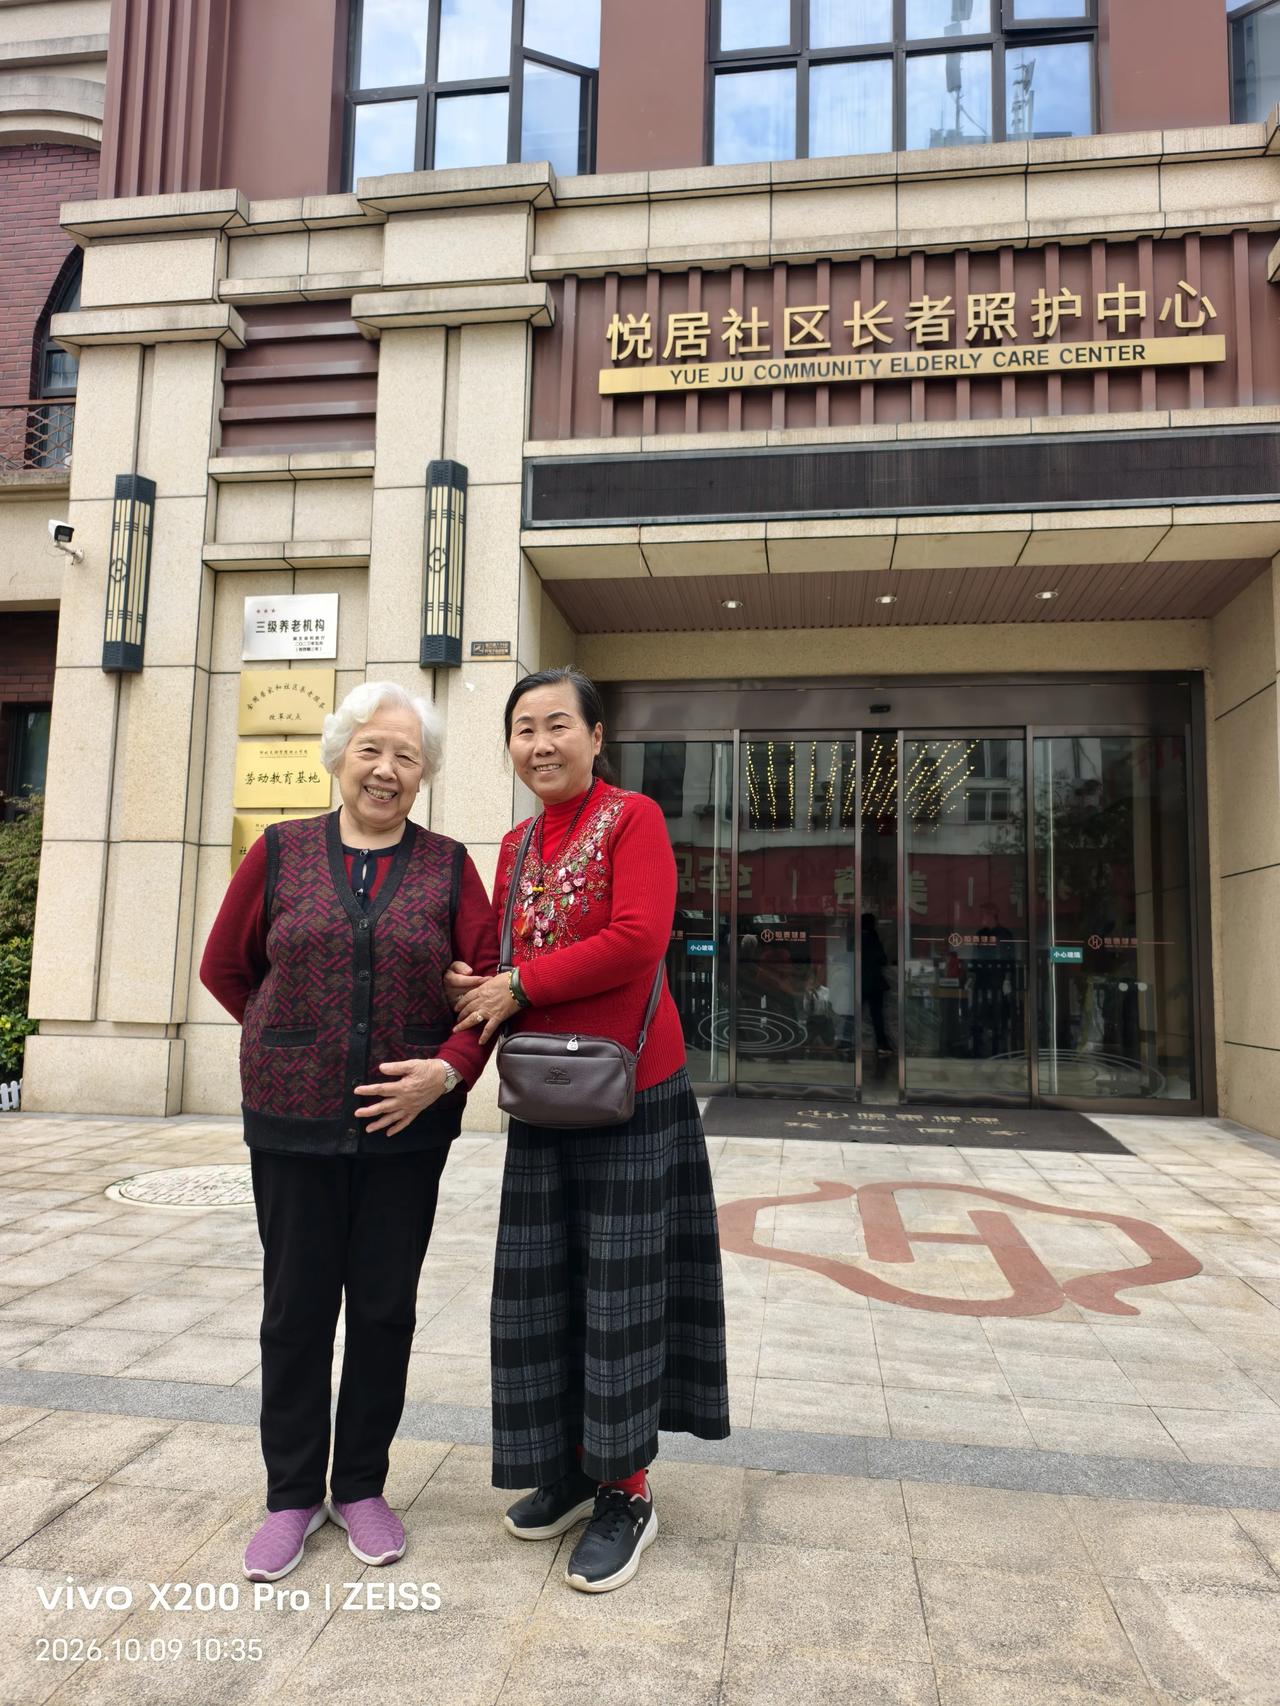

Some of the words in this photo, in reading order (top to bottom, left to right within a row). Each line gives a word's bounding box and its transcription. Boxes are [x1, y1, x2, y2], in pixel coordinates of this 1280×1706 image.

[606, 280, 1218, 361] 悦居社区长者照护中心
[670, 367, 709, 385] YUE
[717, 365, 744, 383] JU
[753, 358, 881, 381] COMMUNITY
[890, 351, 983, 373] ELDERLY
[992, 347, 1049, 368] CARE
[1060, 343, 1146, 365] CENTER
[256, 618, 325, 633] 三级养老机构
[245, 770, 321, 785] 劳动教育基地
